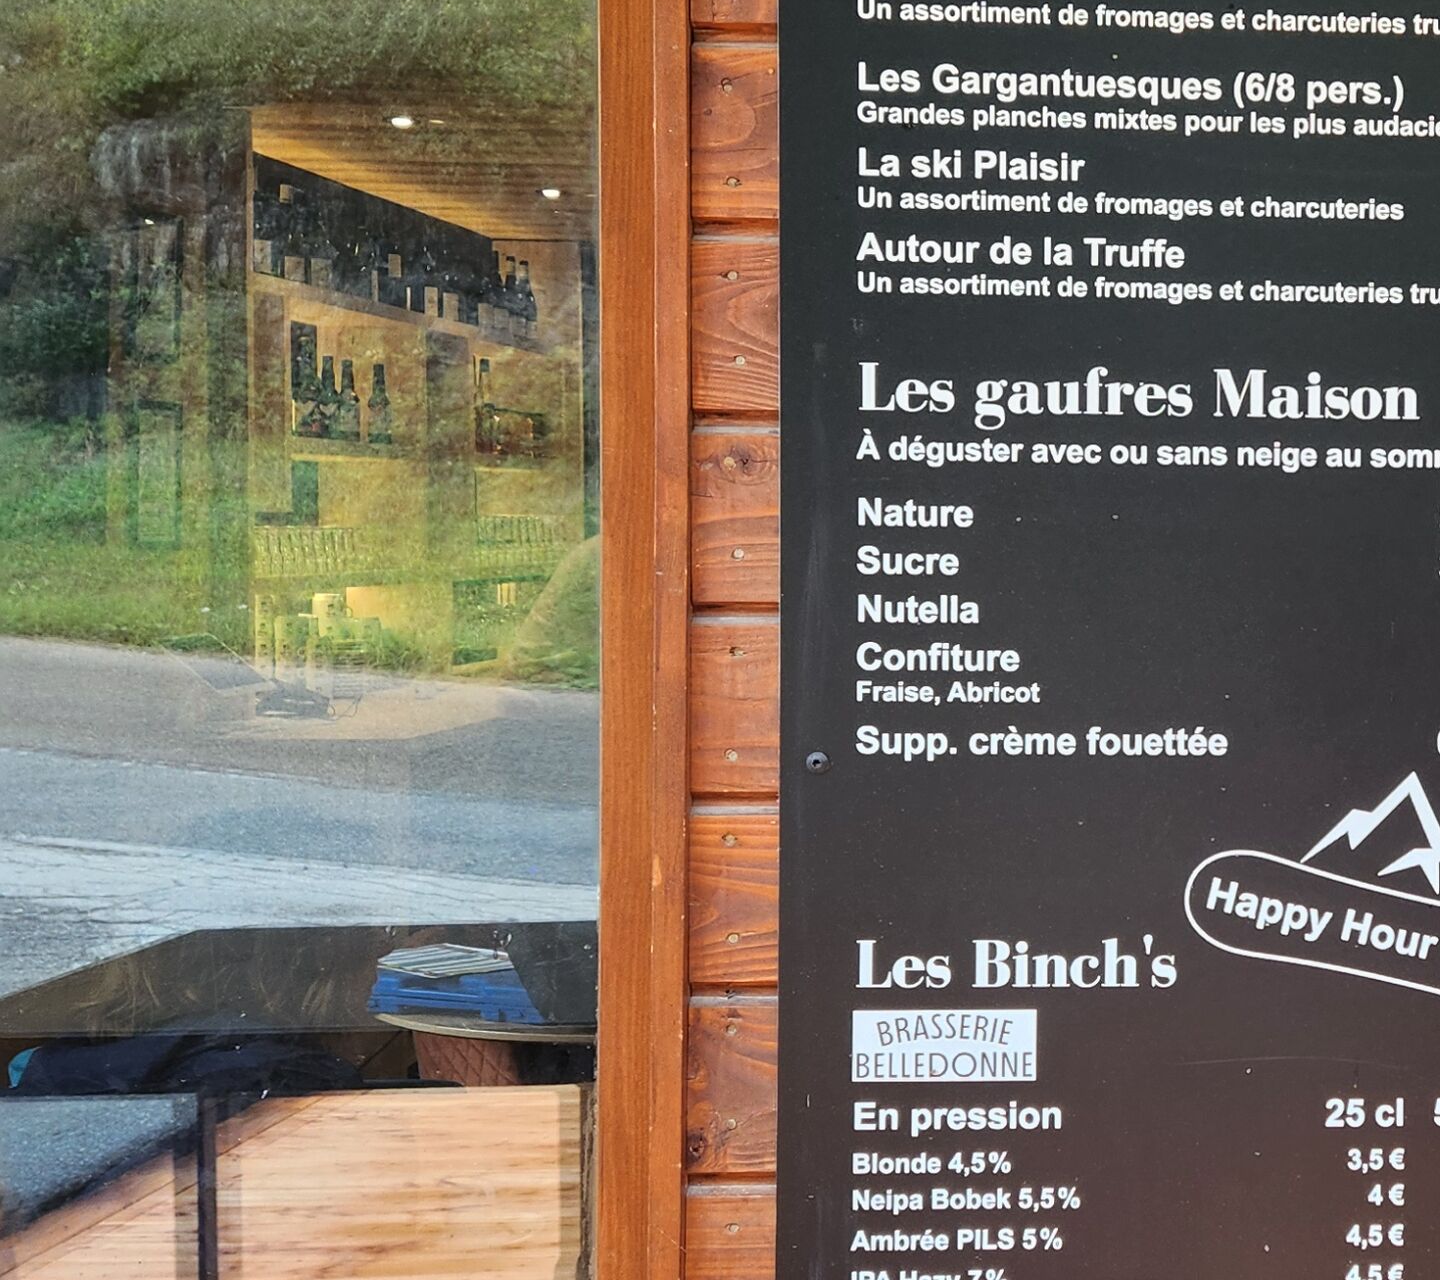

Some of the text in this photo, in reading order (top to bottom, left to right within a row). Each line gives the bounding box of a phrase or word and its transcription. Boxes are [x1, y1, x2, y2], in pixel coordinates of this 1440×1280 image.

[858, 146, 1087, 182] La ski Plaisir
[855, 231, 1186, 269] Autour de la Truffe
[858, 361, 1421, 431] Les gaufres Maison
[855, 427, 881, 461] À
[887, 434, 1025, 468] déguster
[1030, 443, 1103, 465] avec
[1109, 444, 1148, 466] ou
[1156, 444, 1229, 467] sans
[1236, 440, 1318, 474] neige
[1324, 447, 1362, 468] au
[857, 496, 975, 529] Nature
[855, 544, 960, 577] Sucre
[857, 593, 980, 625] Nutella
[855, 641, 1021, 673] Confiture
[855, 680, 1041, 707] Fraise, Abricot
[855, 724, 1229, 763] Supp. crème fouettée
[1206, 876, 1333, 942] Happy
[1340, 908, 1438, 959] Hour
[854, 933, 1178, 989] Les Binch's
[876, 1013, 1013, 1046] BRASSERIE
[856, 1052, 1033, 1078] BELLEDONNE
[853, 1099, 1063, 1138] En pression
[1324, 1096, 1405, 1128] 25 cl
